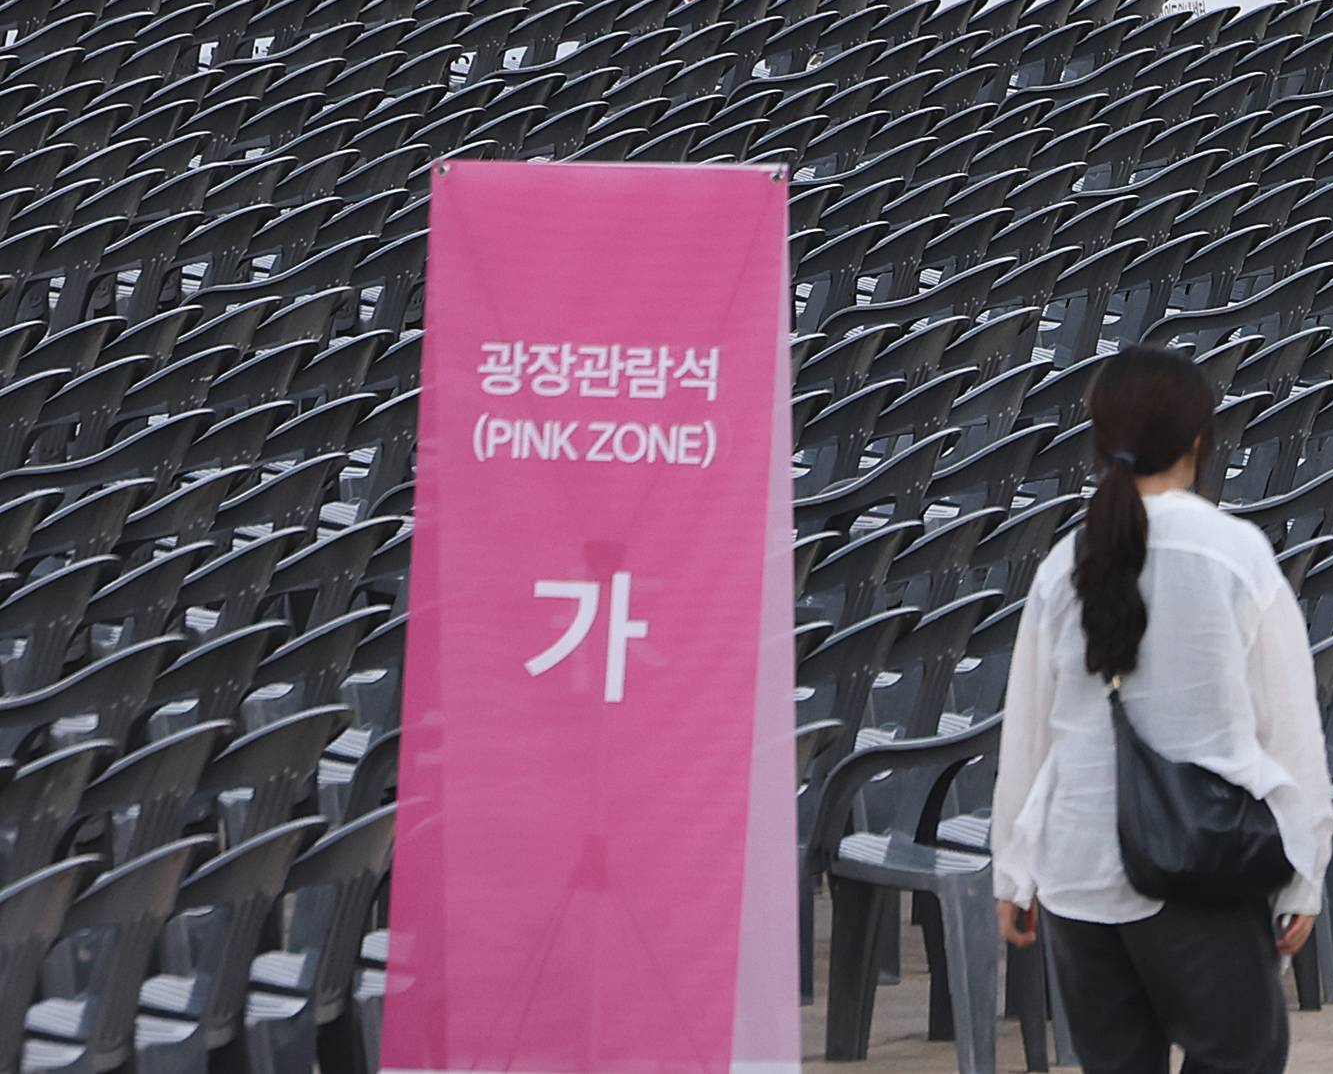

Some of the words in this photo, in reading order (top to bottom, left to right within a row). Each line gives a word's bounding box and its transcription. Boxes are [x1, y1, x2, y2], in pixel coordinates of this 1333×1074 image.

[477, 340, 720, 402] 광장관람석
[473, 412, 580, 462] (PINK
[585, 419, 717, 469] ZONE)
[524, 571, 648, 703] 가
